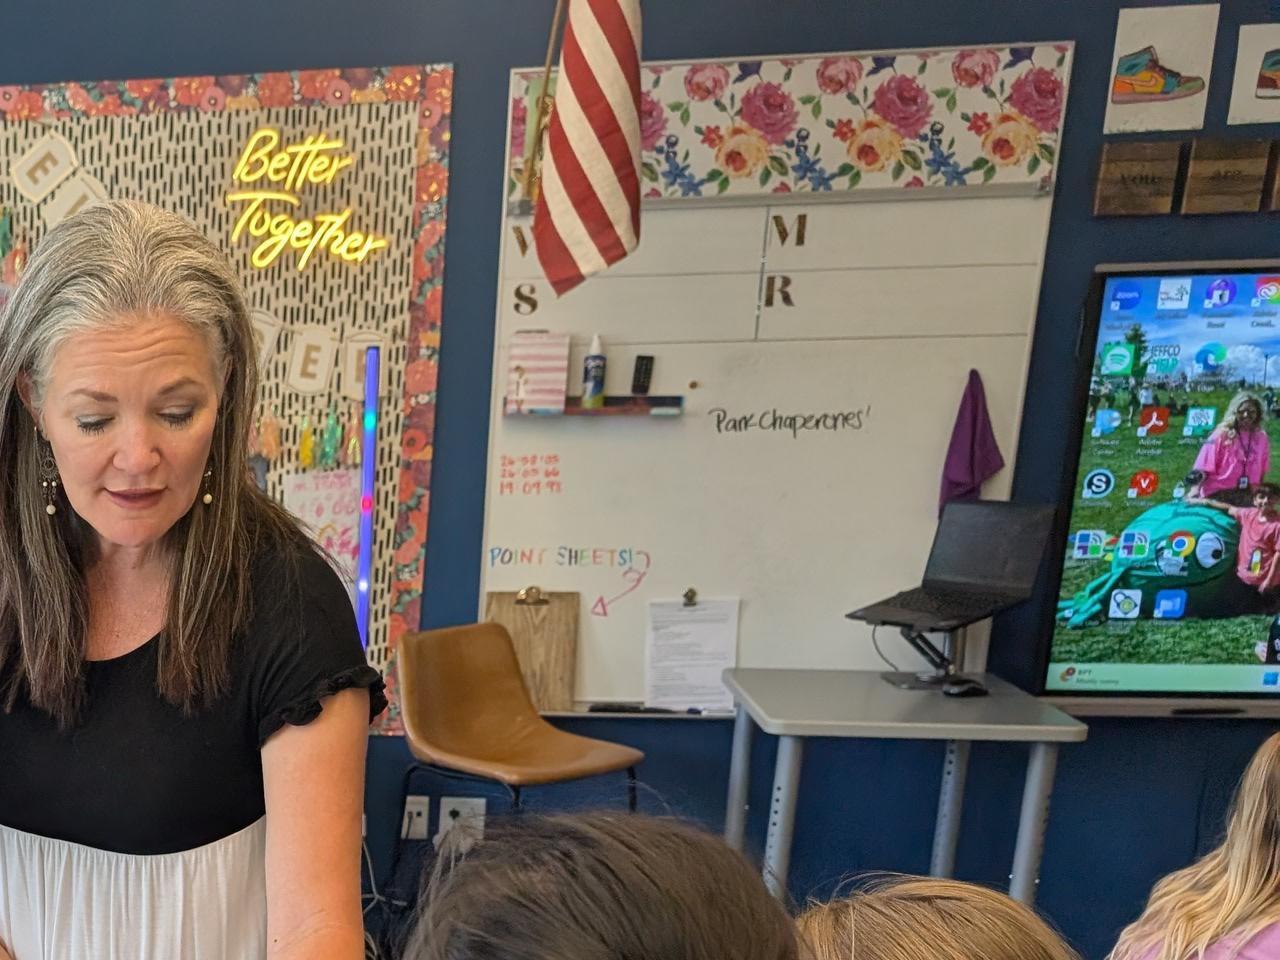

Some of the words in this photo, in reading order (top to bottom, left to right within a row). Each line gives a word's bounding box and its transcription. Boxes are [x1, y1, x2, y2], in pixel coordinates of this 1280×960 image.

[232, 128, 353, 191] Better
[226, 191, 388, 271] Together
[772, 214, 807, 246] M
[513, 284, 538, 315] S
[764, 275, 795, 307] R
[708, 408, 757, 434] Park
[490, 547, 546, 568] POINT
